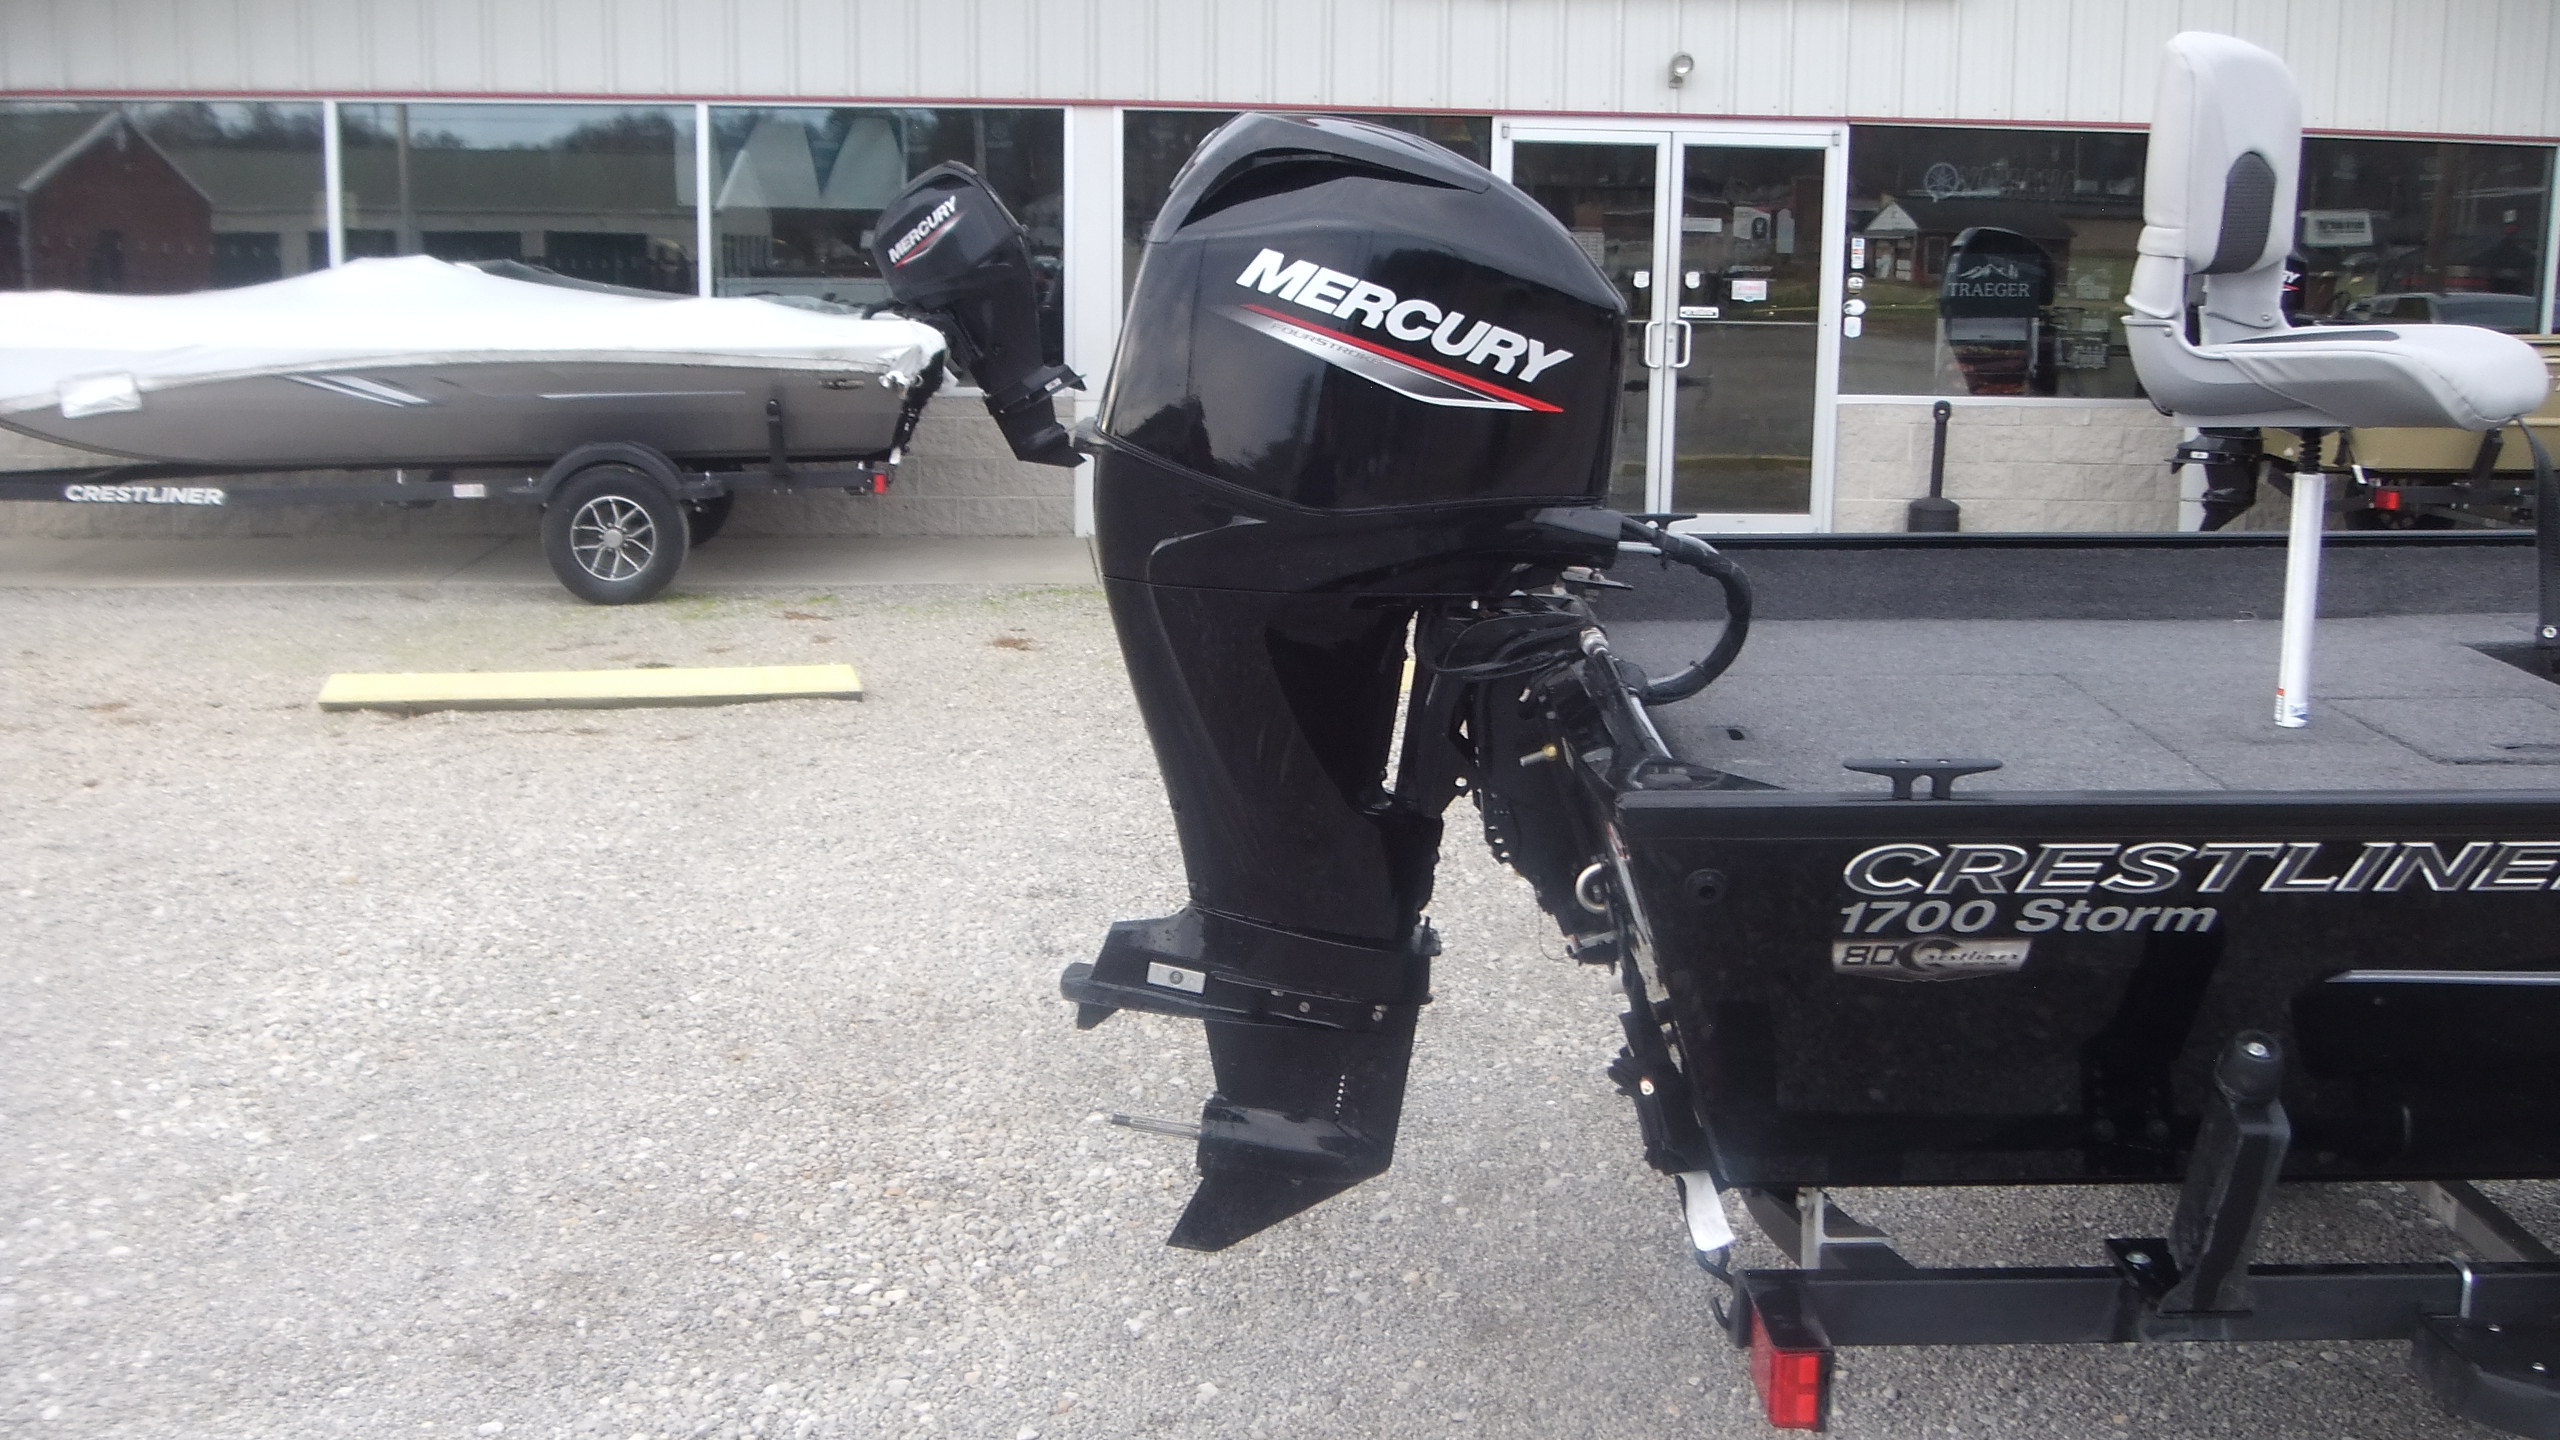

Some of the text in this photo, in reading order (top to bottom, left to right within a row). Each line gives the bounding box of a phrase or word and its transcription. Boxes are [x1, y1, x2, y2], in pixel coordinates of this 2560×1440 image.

[888, 195, 957, 264] MERCURY
[1948, 282, 2031, 298] TRAEGER
[1236, 248, 1574, 384] MERCURY
[1270, 321, 1383, 365] FOURSTROKE
[64, 484, 226, 506] CRESTLINER
[1842, 841, 2560, 894] CRESTLINE
[1841, 898, 2218, 934] 1700 Storm
